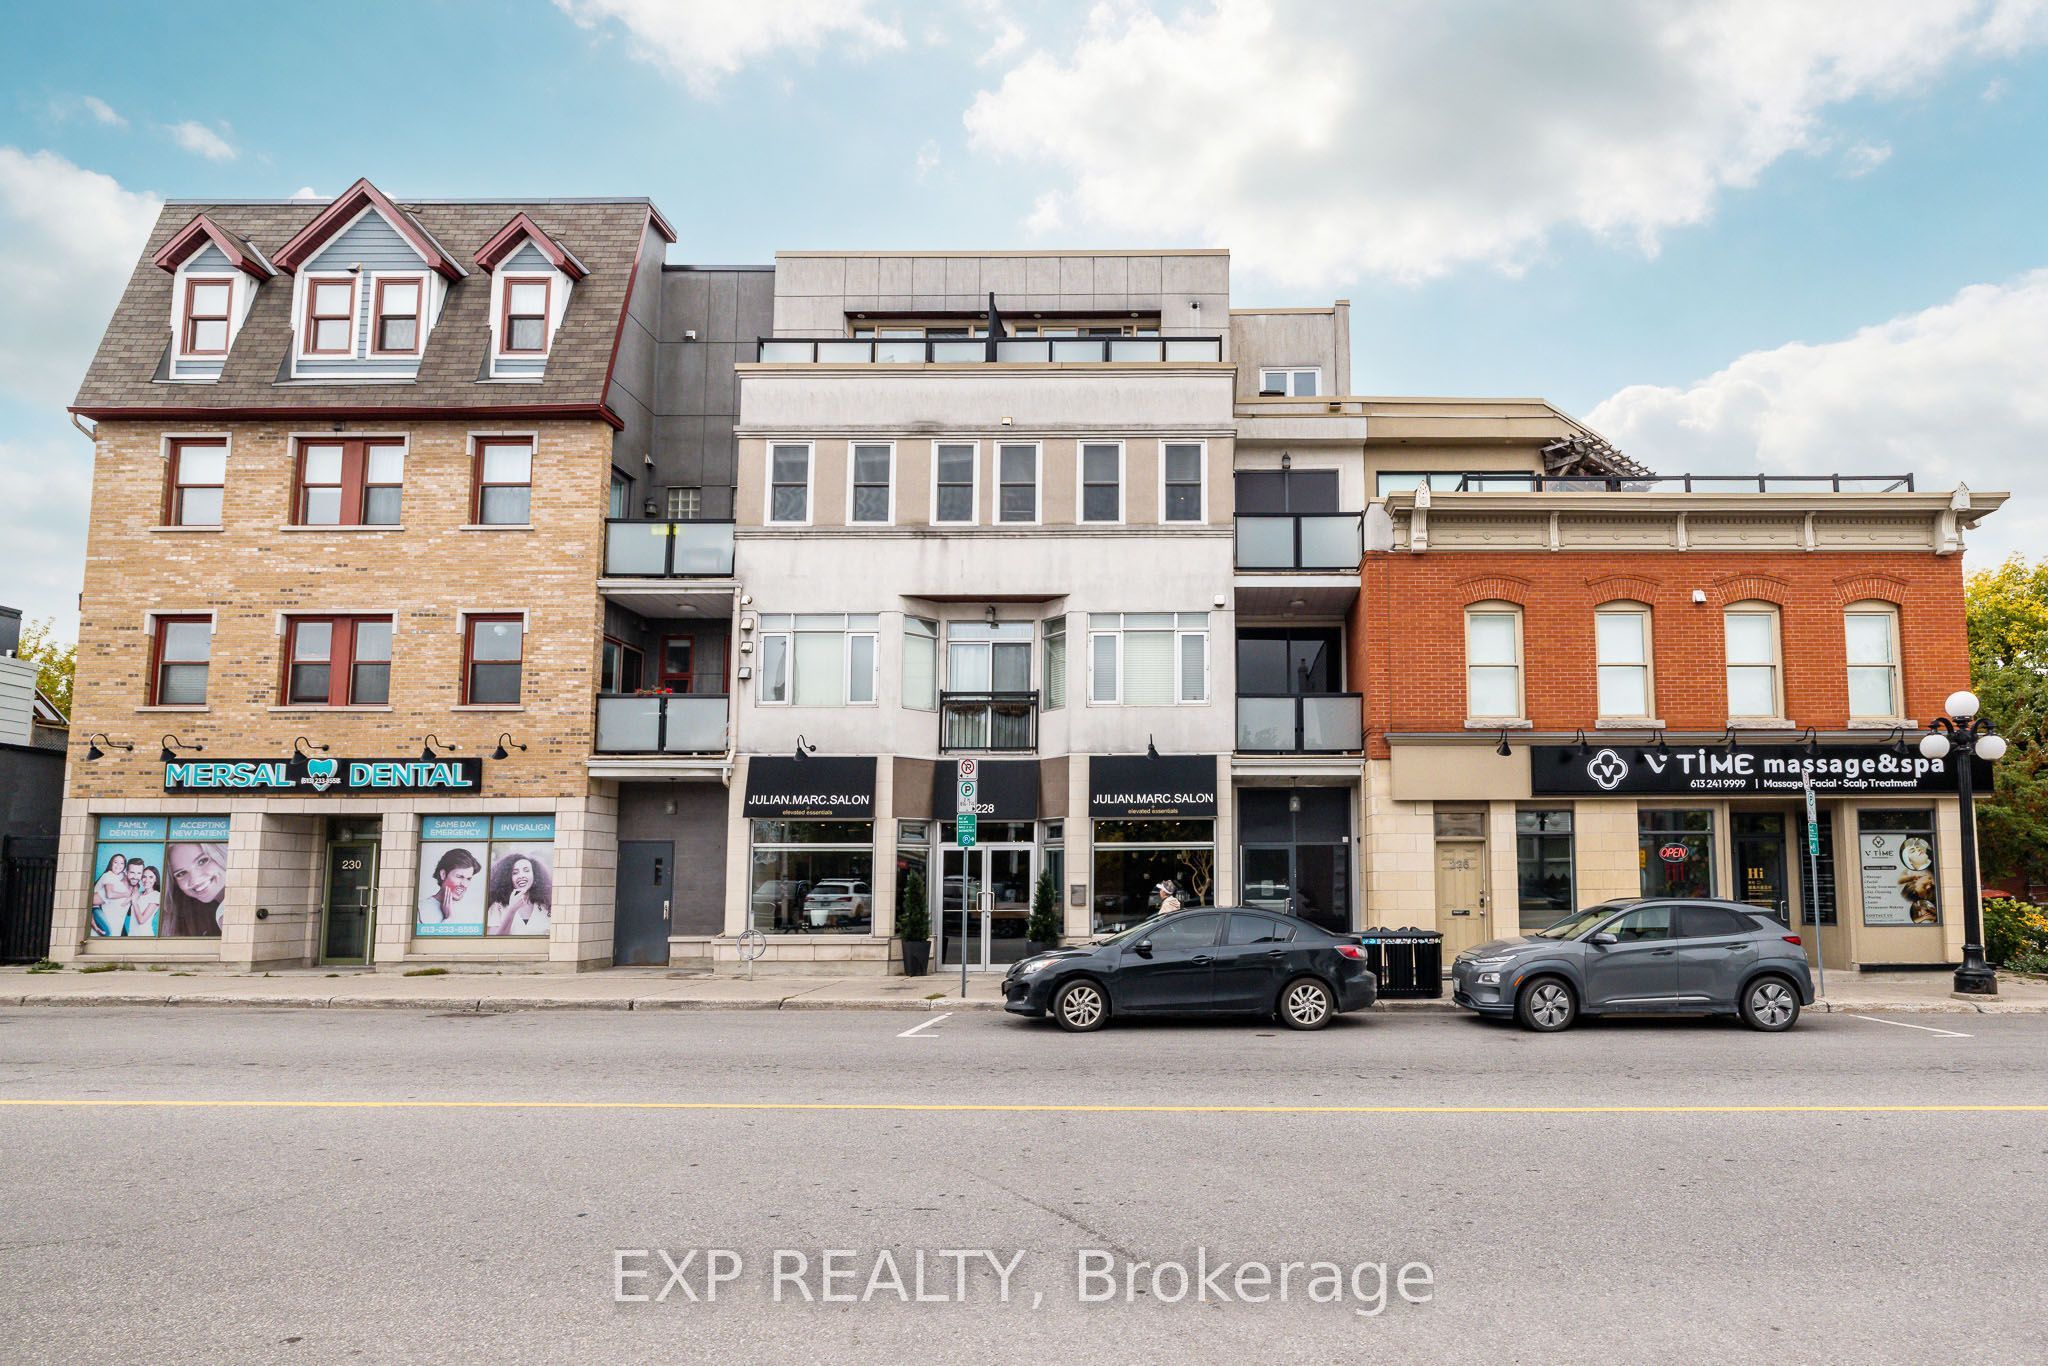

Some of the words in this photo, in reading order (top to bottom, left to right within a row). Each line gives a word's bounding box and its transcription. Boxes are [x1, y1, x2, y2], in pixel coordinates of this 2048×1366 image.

[1764, 754, 1945, 778] massage&spa
[166, 763, 296, 788] MERSAL
[350, 762, 473, 787] DENTAL
[1690, 779, 1705, 788] 613
[1706, 779, 1722, 788] 241
[1723, 779, 1746, 788] 9999
[1763, 779, 1803, 790] Massage
[1810, 778, 1837, 788] Facial
[1843, 779, 1867, 790] Scalp
[1869, 778, 1918, 788] Treatment
[748, 794, 870, 805] JULIAN.MARC.SALON
[1092, 793, 1214, 804] JULIAN.MARC.SALON
[976, 804, 995, 813] 228
[501, 823, 551, 831] INVISALIGN
[172, 829, 194, 837] NEW
[1661, 847, 1687, 858] OPEN
[342, 860, 362, 870] 230
[1748, 867, 1763, 878] Hi
